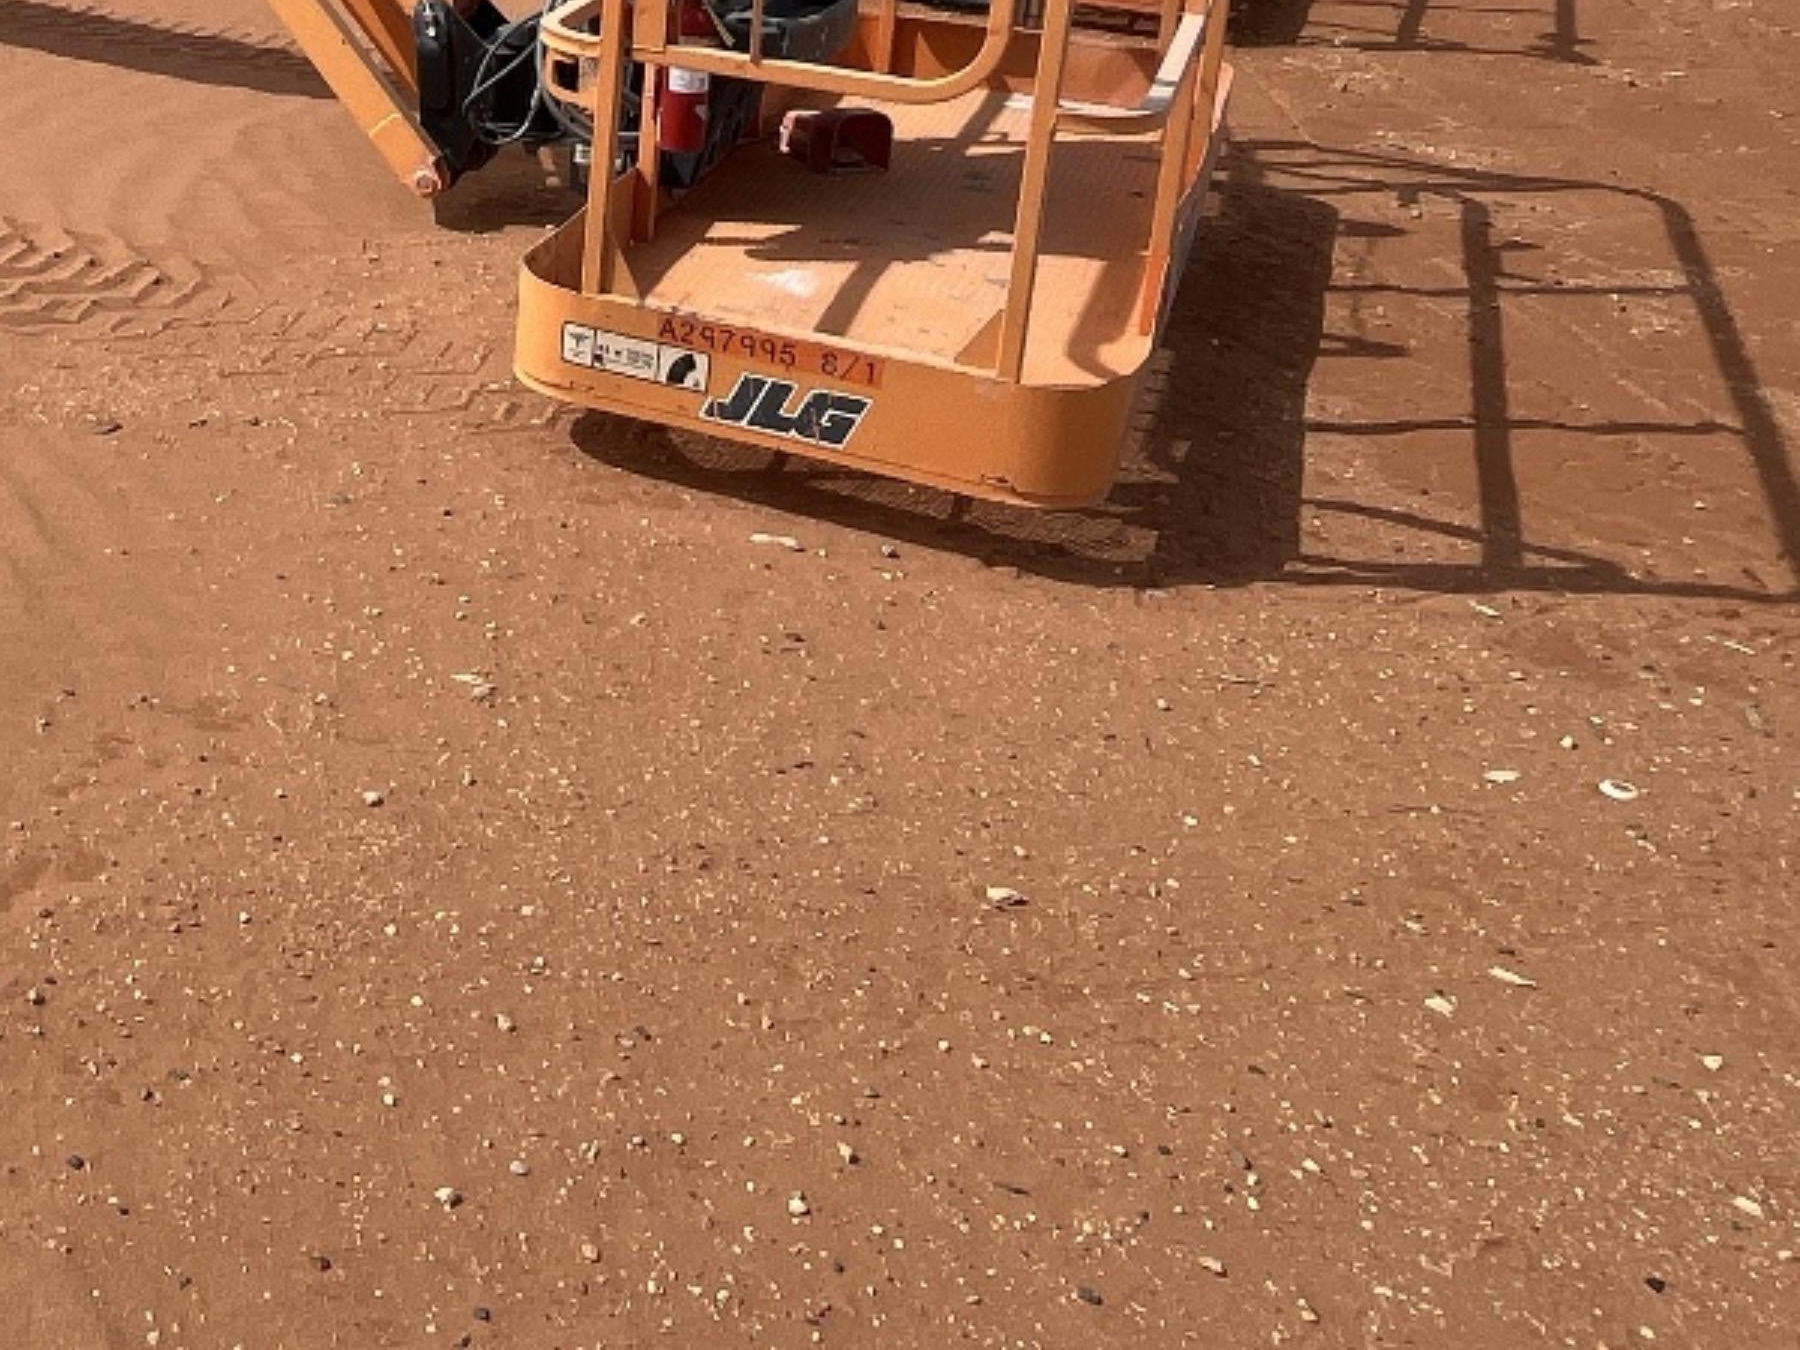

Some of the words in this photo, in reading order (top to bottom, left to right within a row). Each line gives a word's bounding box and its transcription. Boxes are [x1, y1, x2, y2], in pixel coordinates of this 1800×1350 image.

[657, 316, 799, 369] A297995
[820, 352, 876, 385] 8/1
[700, 371, 874, 449] JLG
